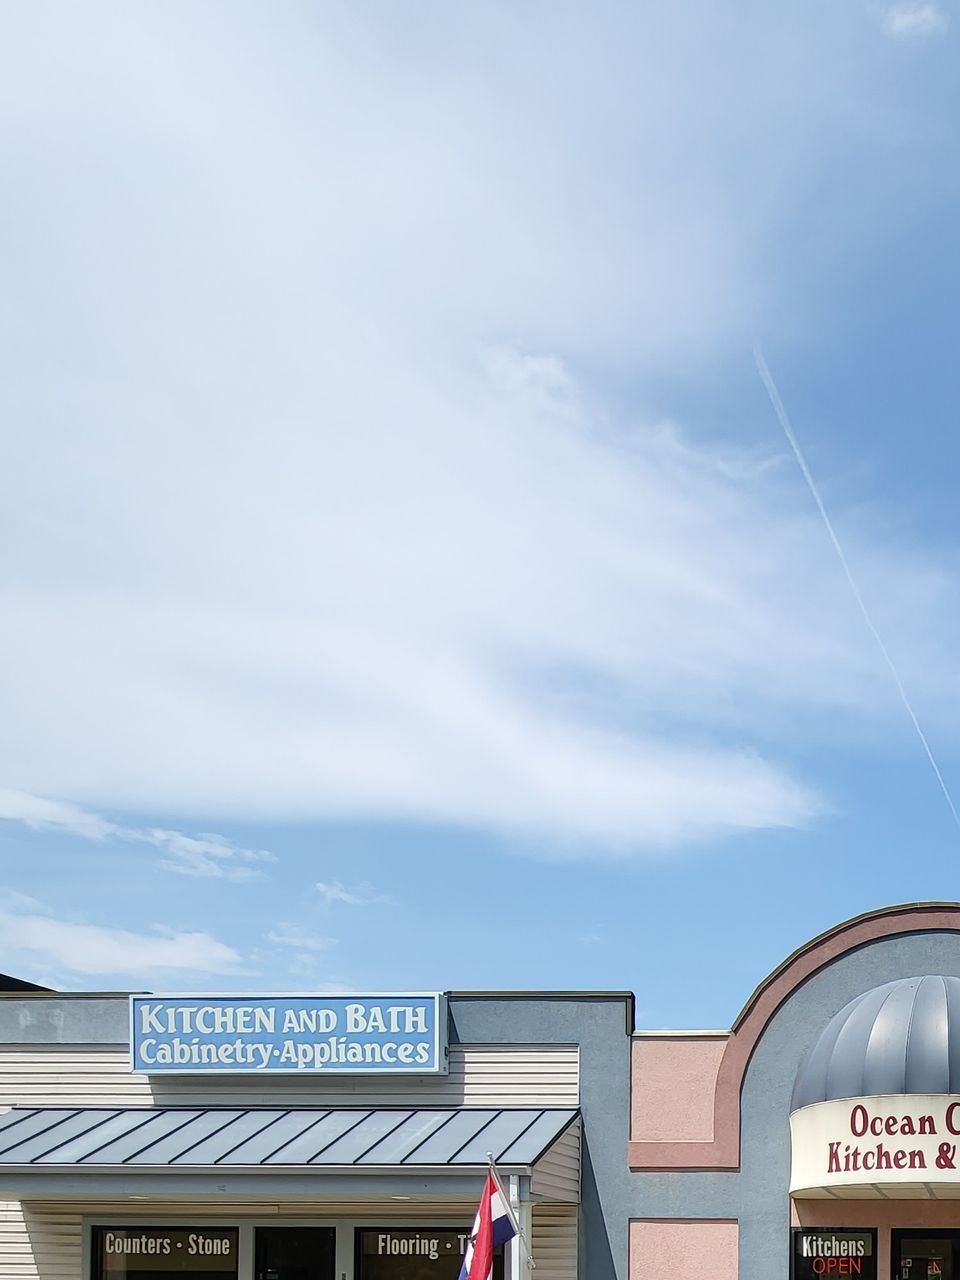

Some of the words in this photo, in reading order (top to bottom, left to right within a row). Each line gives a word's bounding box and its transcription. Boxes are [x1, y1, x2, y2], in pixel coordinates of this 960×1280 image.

[140, 1004, 275, 1034] KITCHEN
[282, 1009, 338, 1033] AND
[345, 1003, 428, 1033] BATH
[850, 1104, 937, 1137] Ocean
[827, 1141, 927, 1173] Kitchen
[935, 1142, 957, 1170] &
[105, 1233, 171, 1254] Counters
[188, 1234, 230, 1255] Stone
[378, 1234, 440, 1260] Flooring
[802, 1236, 865, 1257] Kitchens
[812, 1257, 861, 1274] OPEN
